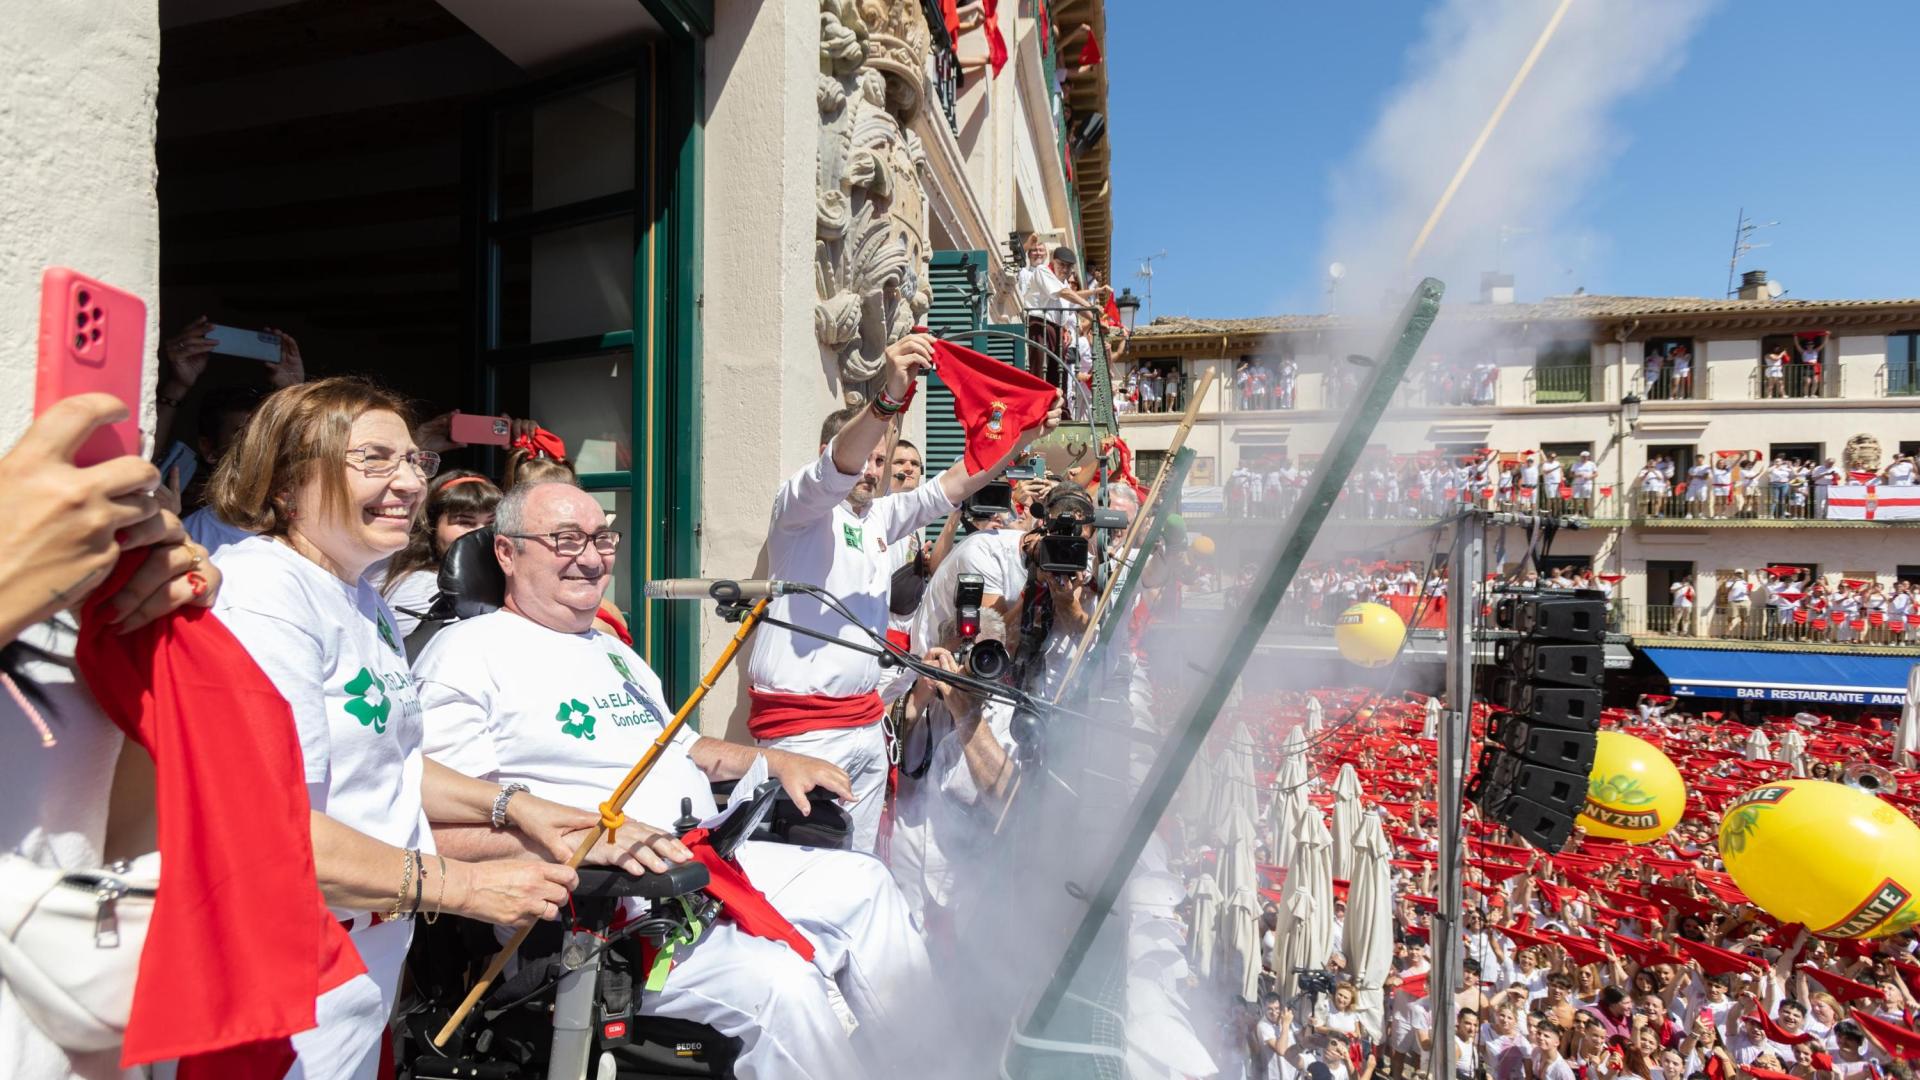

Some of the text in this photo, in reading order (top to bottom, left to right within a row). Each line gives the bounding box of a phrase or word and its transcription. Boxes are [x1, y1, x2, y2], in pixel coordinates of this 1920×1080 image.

[592, 696, 610, 709] La
[608, 692, 636, 708] ELA
[1736, 688, 1764, 698] BAR
[1770, 689, 1864, 703] RESTAURANTE
[1585, 802, 1653, 827] URZAN
